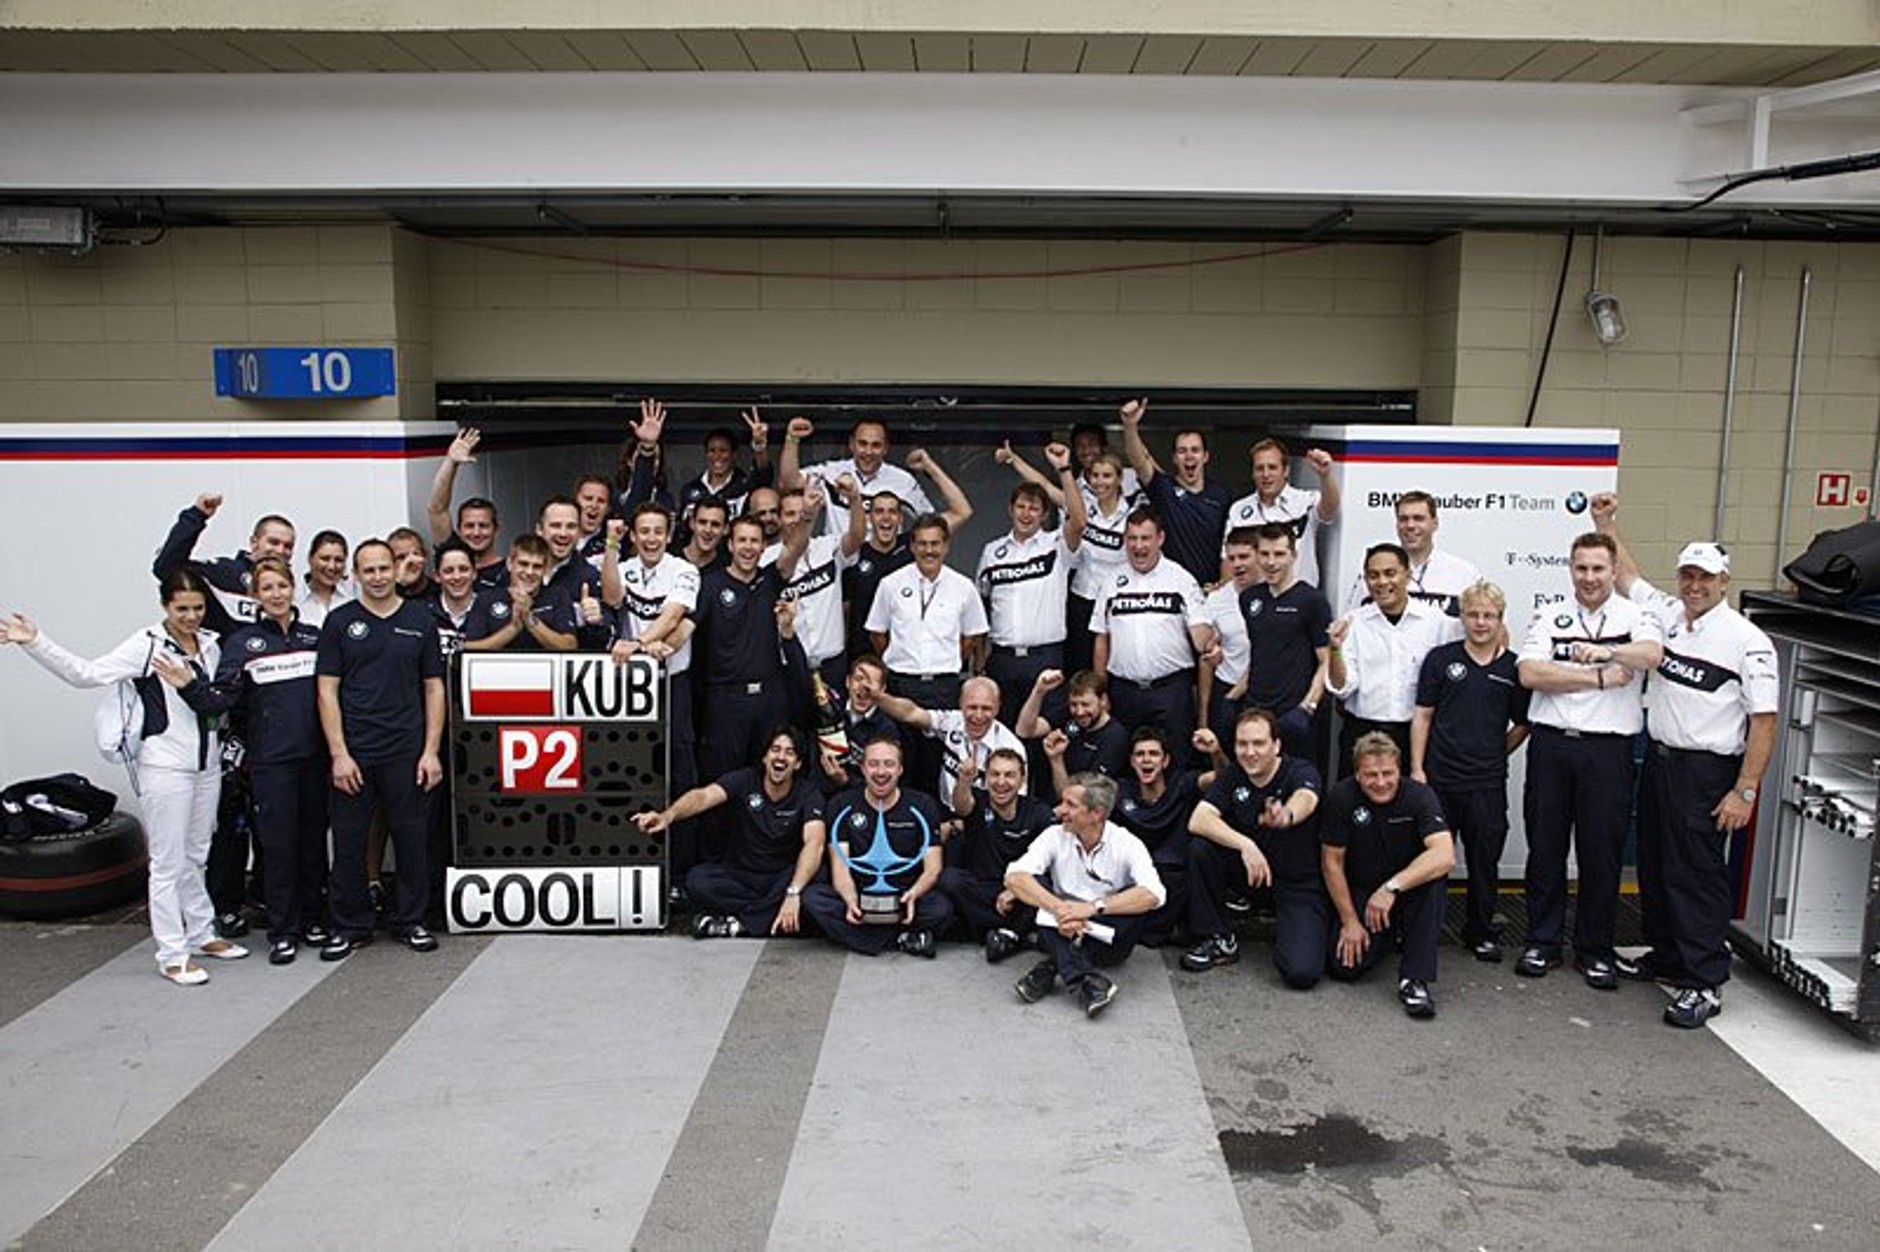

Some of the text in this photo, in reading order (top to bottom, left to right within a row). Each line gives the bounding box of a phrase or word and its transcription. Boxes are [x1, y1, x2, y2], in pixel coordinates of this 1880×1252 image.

[239, 353, 258, 393] 10
[301, 351, 351, 392] 10
[1368, 491, 1401, 508] BM
[1485, 494, 1505, 509] F1
[1509, 494, 1555, 511] Team
[565, 660, 654, 717] KUB
[501, 730, 579, 789] P2
[450, 872, 616, 929] COOL
